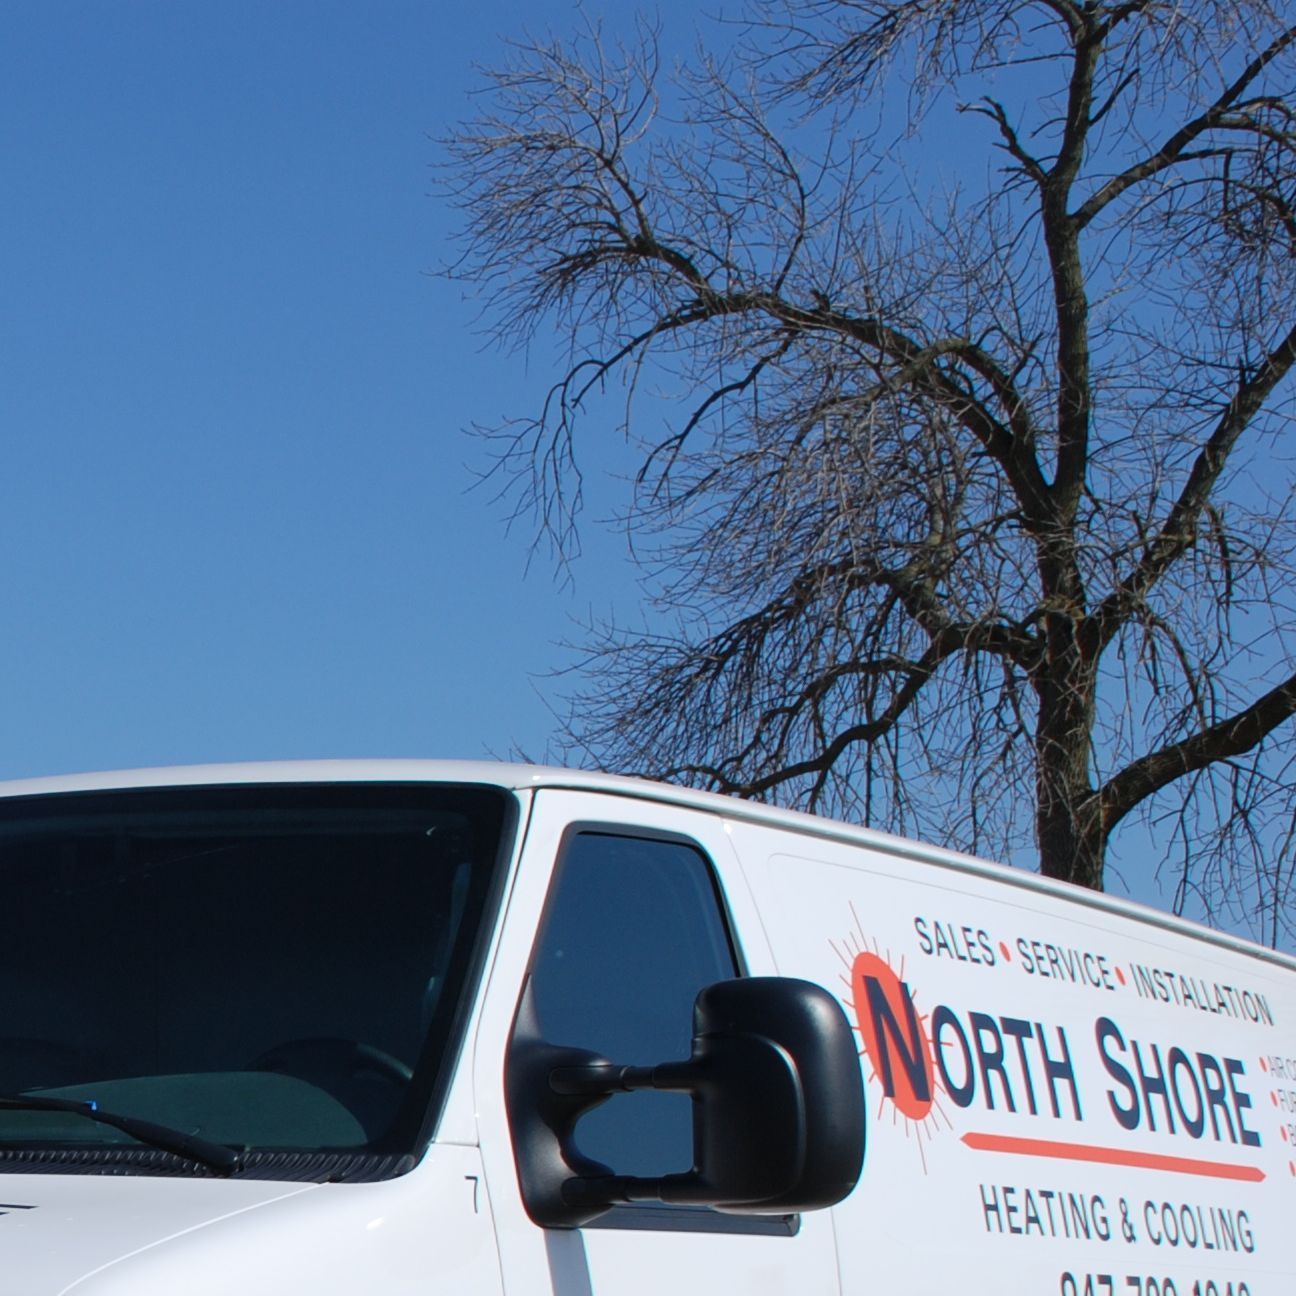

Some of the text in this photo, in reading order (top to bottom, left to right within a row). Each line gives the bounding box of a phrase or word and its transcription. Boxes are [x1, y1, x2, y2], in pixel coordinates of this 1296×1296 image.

[914, 917, 1275, 1026] SALES SERVICE INSTALLATION
[863, 975, 1262, 1147] NORTH SHORE
[464, 1176, 478, 1214] 7
[980, 1184, 1255, 1253] HEATING & COOLING
